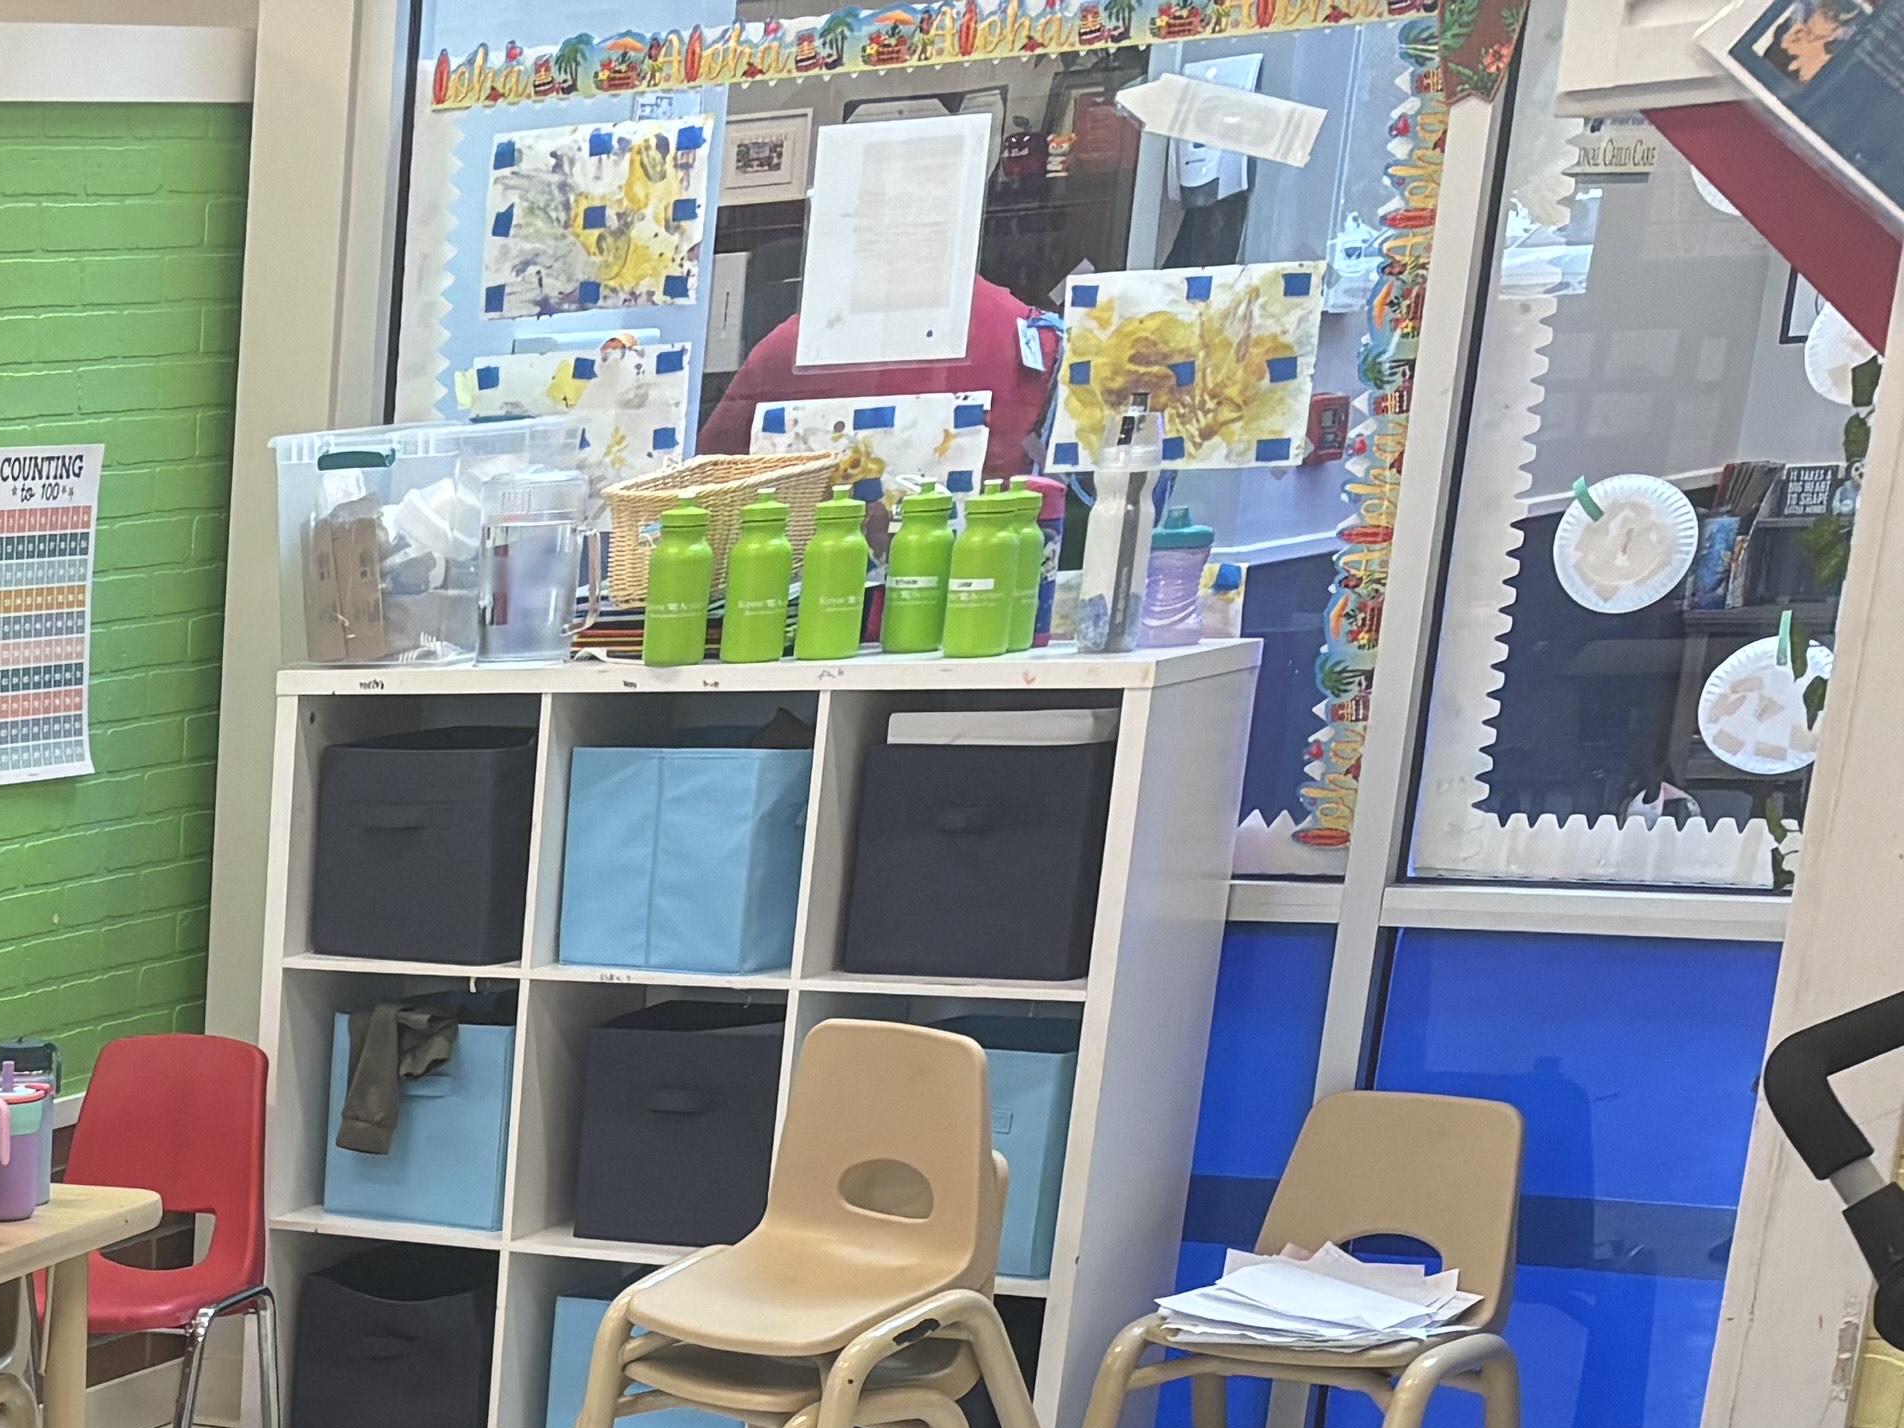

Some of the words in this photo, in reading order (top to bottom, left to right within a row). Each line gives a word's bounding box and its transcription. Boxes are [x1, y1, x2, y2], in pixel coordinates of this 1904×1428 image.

[0, 454, 84, 482] COUNTING
[21, 484, 35, 502] to
[41, 482, 60, 501] 100
